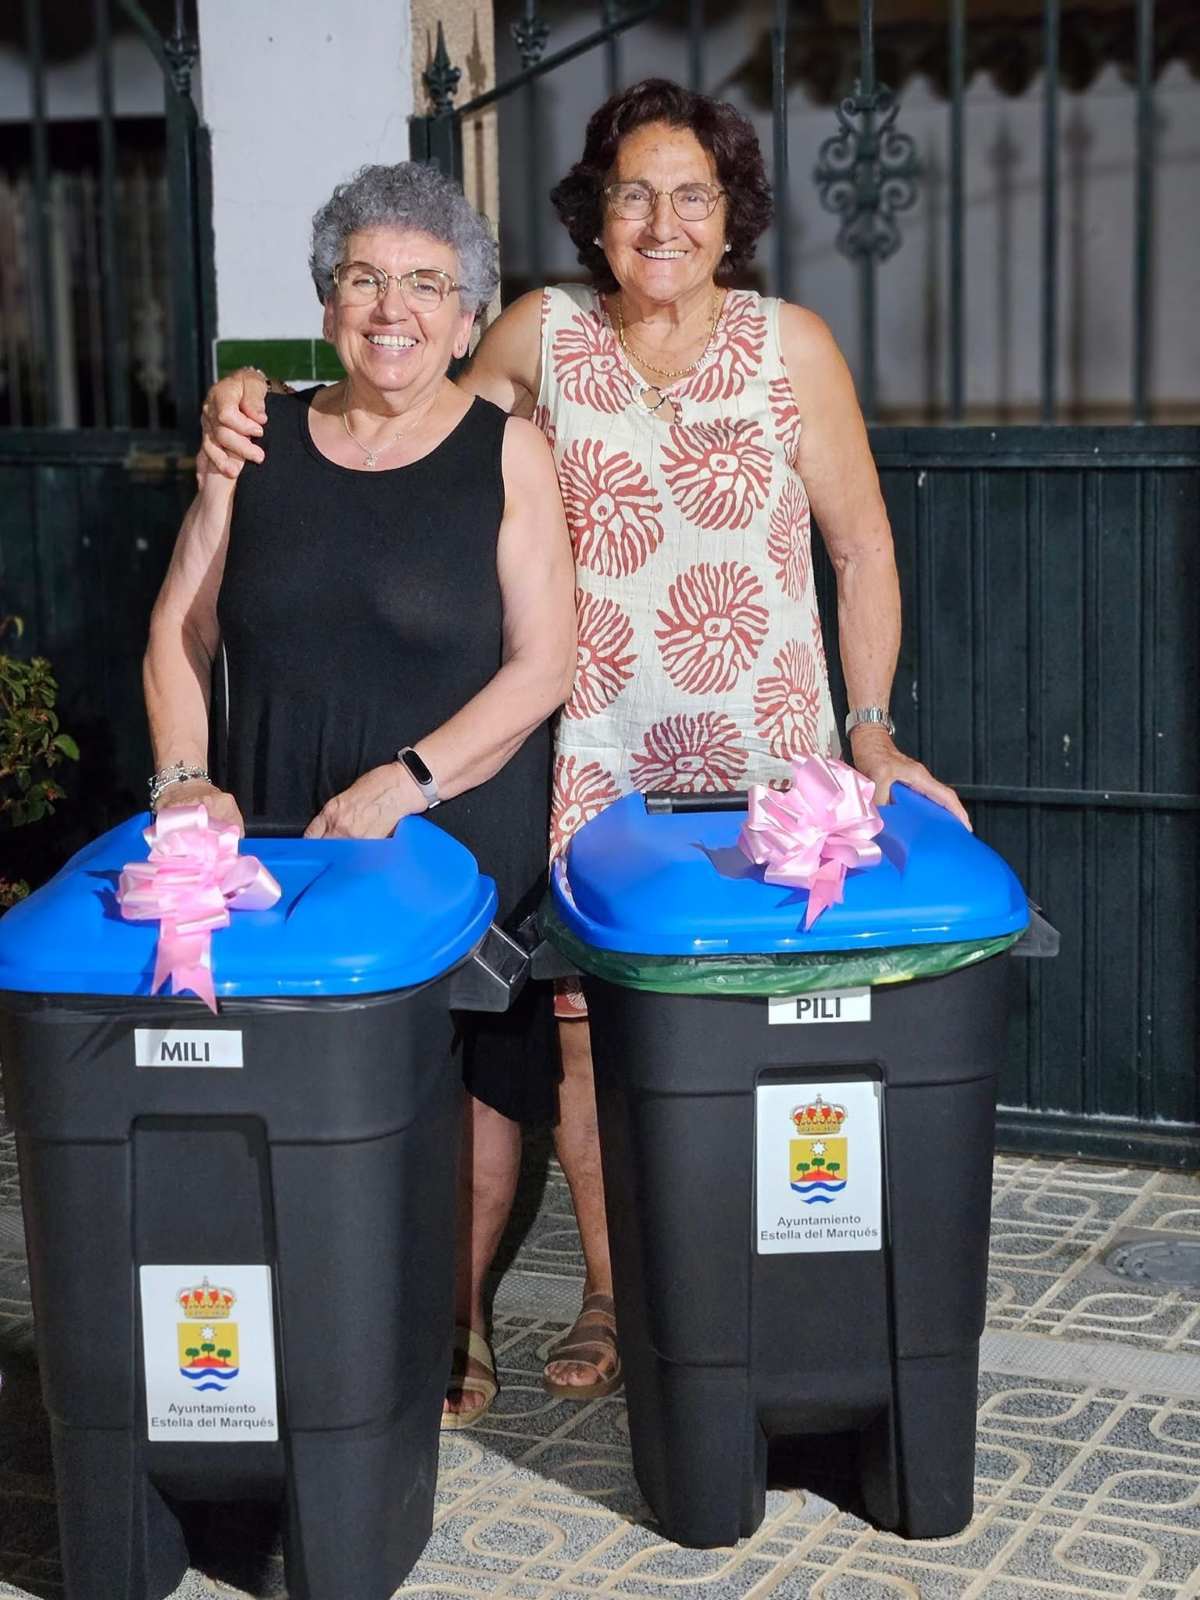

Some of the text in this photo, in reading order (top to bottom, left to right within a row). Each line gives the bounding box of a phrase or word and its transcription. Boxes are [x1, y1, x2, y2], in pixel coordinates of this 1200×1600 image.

[796, 997, 841, 1019] PILI
[160, 1042, 210, 1062] MILI
[777, 1215, 861, 1228] Ayuntamiento
[760, 1227, 878, 1240] Estella del Marqués
[168, 1402, 256, 1416] Ayuntamiento
[151, 1416, 274, 1429] Estella del Marqués
